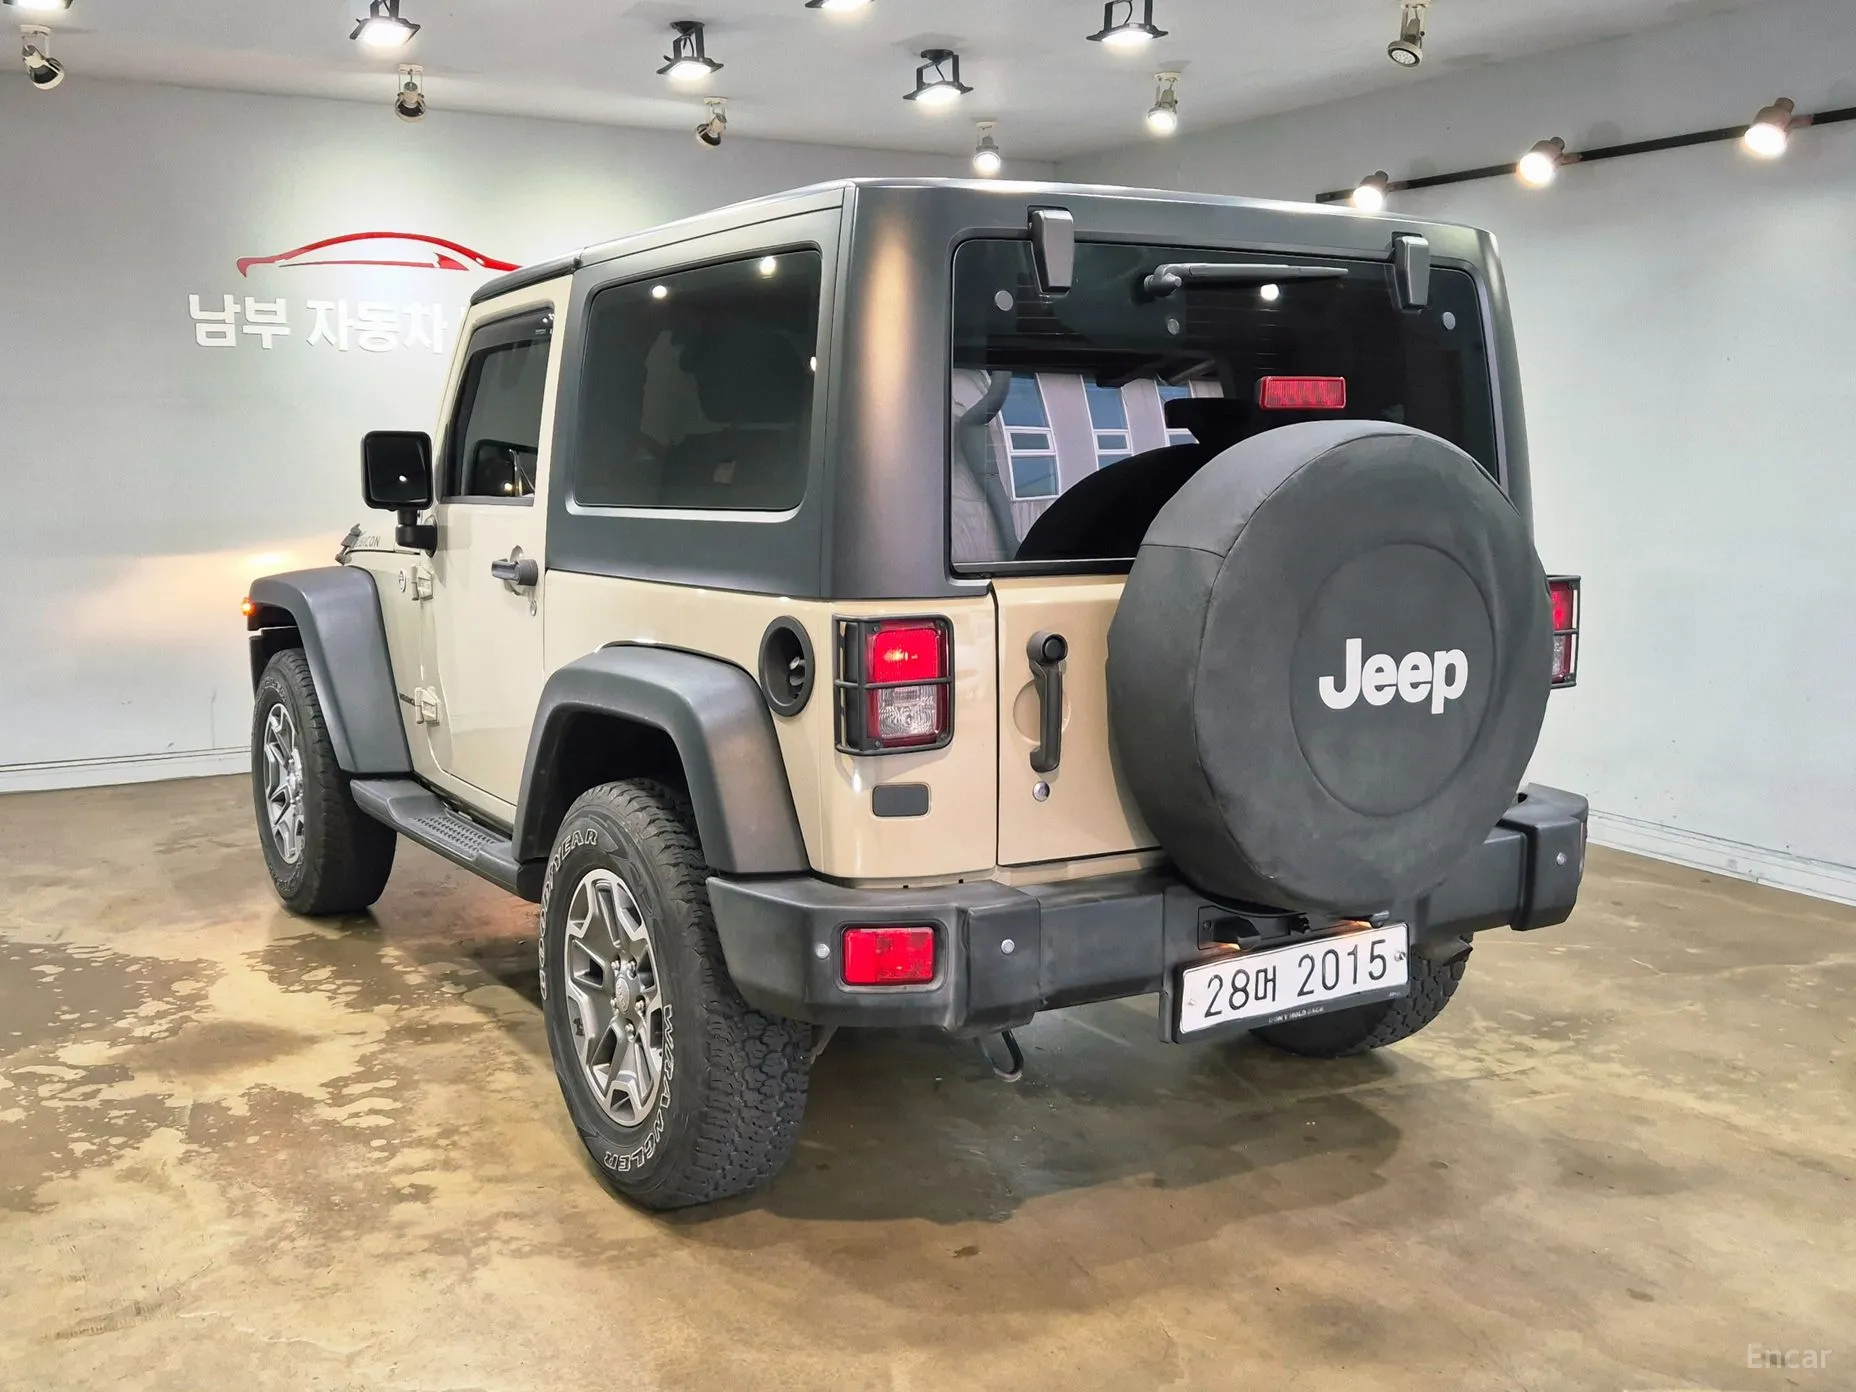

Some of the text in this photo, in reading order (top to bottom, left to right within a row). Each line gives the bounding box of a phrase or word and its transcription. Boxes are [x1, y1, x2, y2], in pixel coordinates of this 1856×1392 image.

[188, 293, 448, 354] 남부 자동차
[1318, 637, 1469, 715] Jeep
[538, 828, 599, 1001] GOODYEAR
[1203, 938, 1388, 1019] 28머 2015
[603, 1003, 675, 1173] WRANGLER
